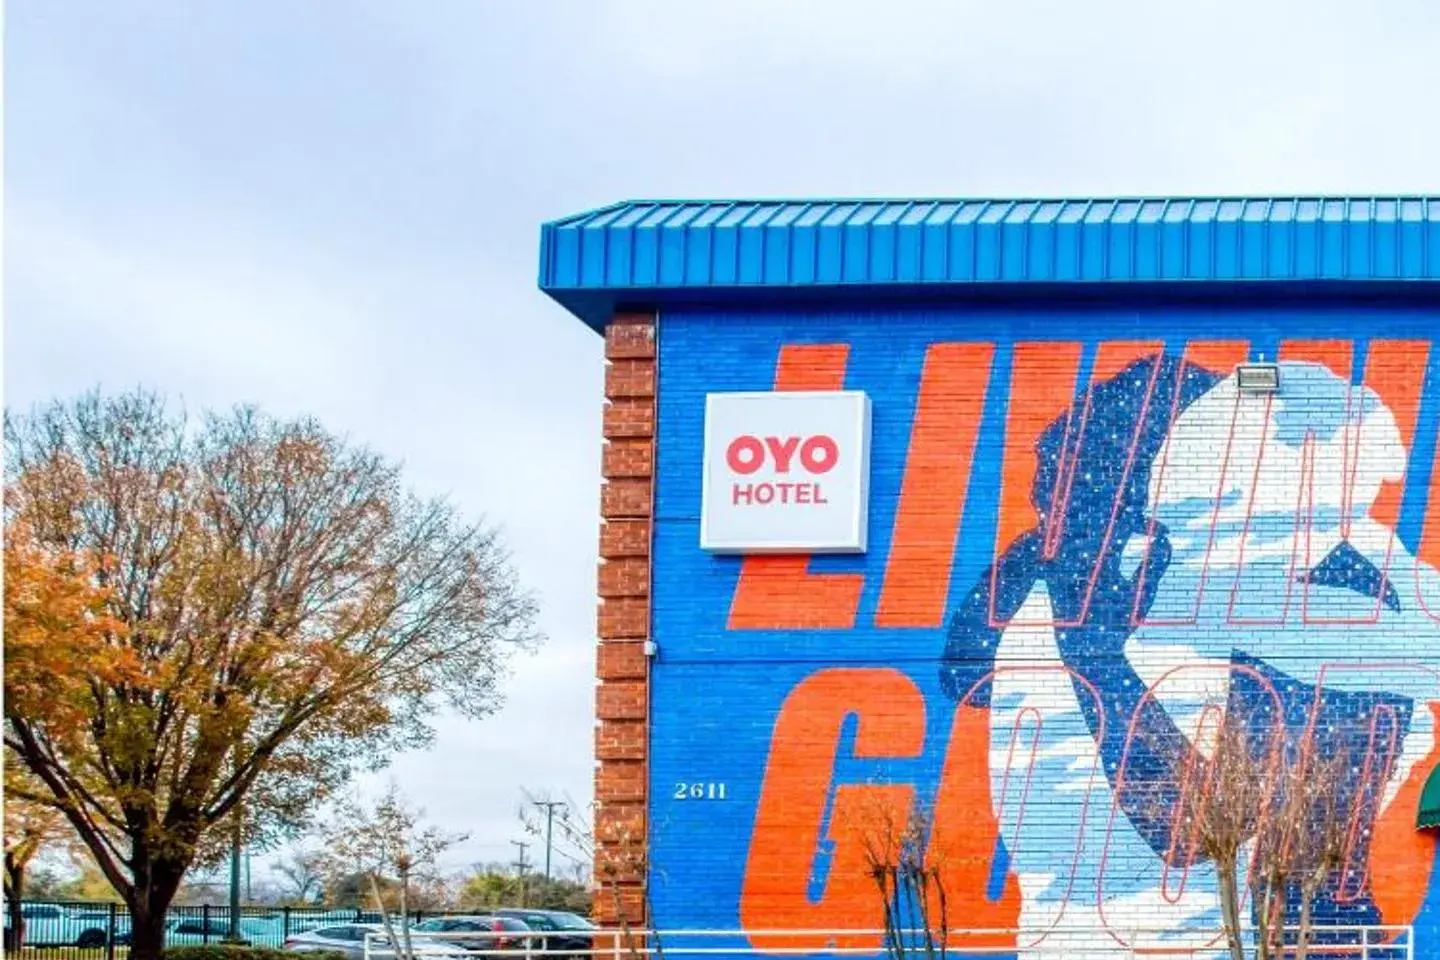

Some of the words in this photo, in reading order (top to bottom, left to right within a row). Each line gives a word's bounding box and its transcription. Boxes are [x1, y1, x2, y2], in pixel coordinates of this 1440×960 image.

[726, 434, 839, 474] OYO
[732, 483, 828, 505] HOTEL
[673, 782, 726, 800] 2611
